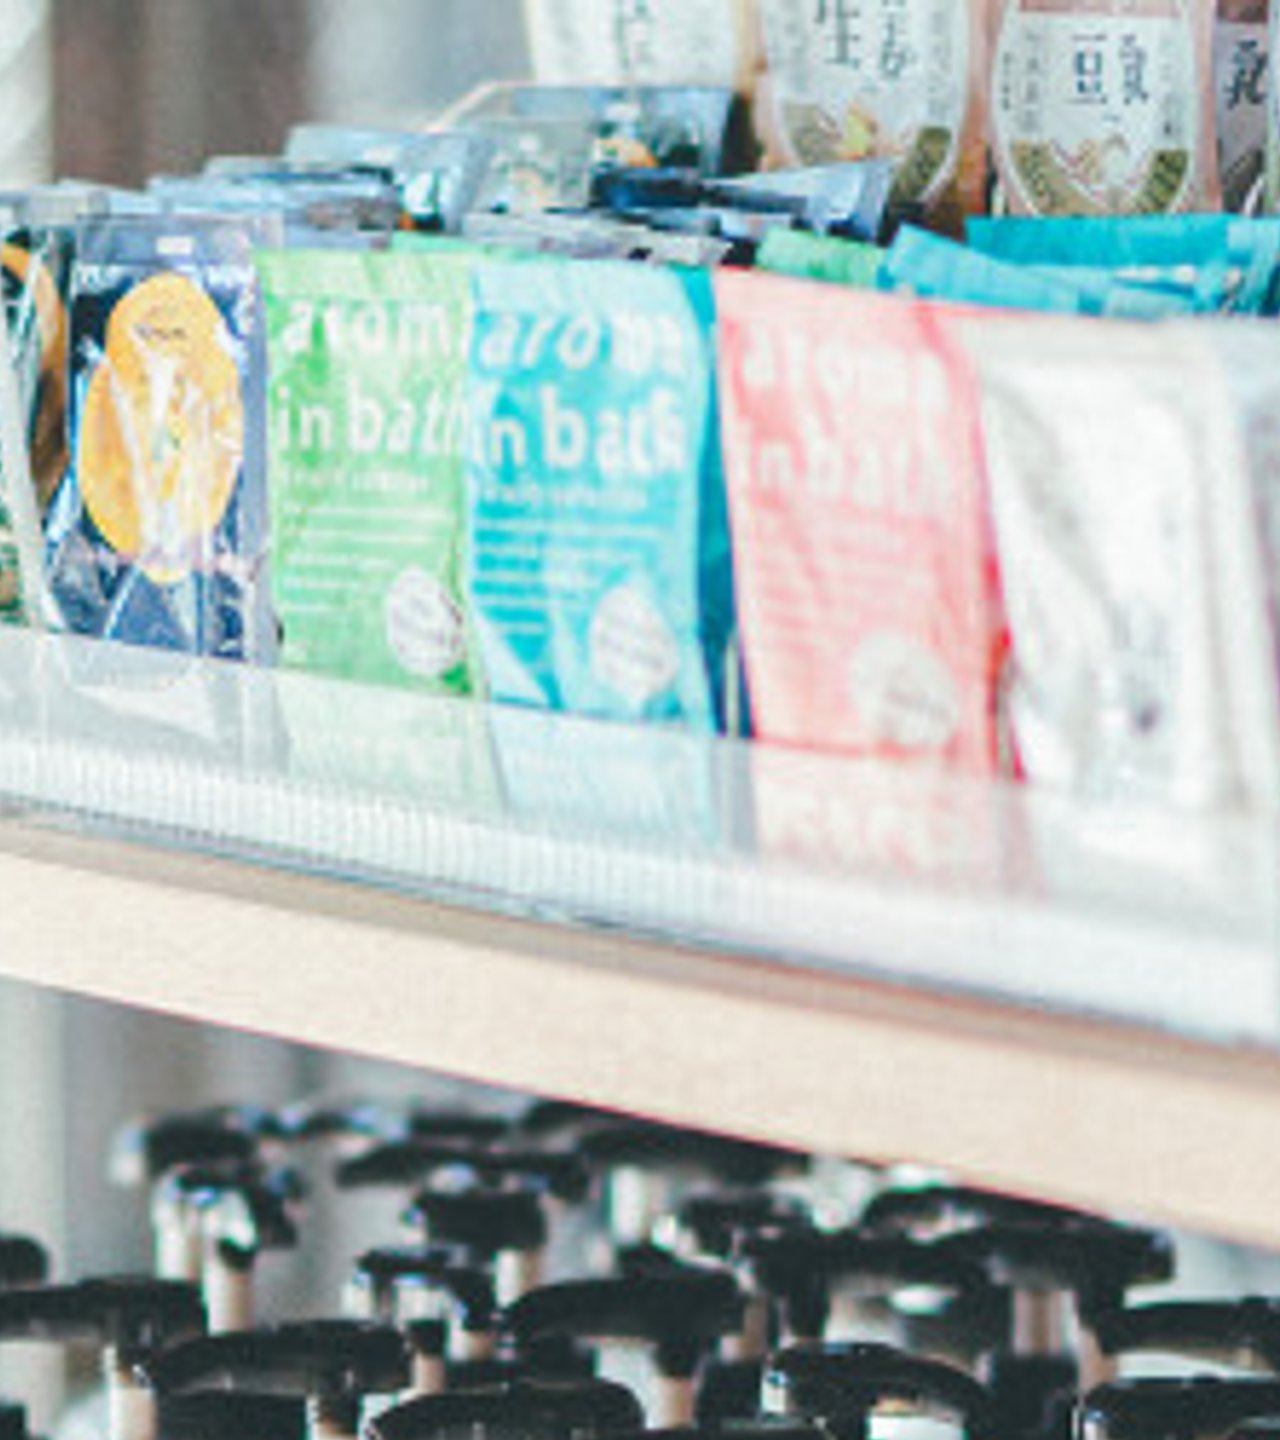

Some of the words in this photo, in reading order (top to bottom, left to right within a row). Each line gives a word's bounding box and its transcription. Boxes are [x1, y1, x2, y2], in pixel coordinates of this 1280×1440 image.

[282, 302, 472, 360] arom
[276, 384, 332, 450] in
[541, 382, 686, 480] bath
